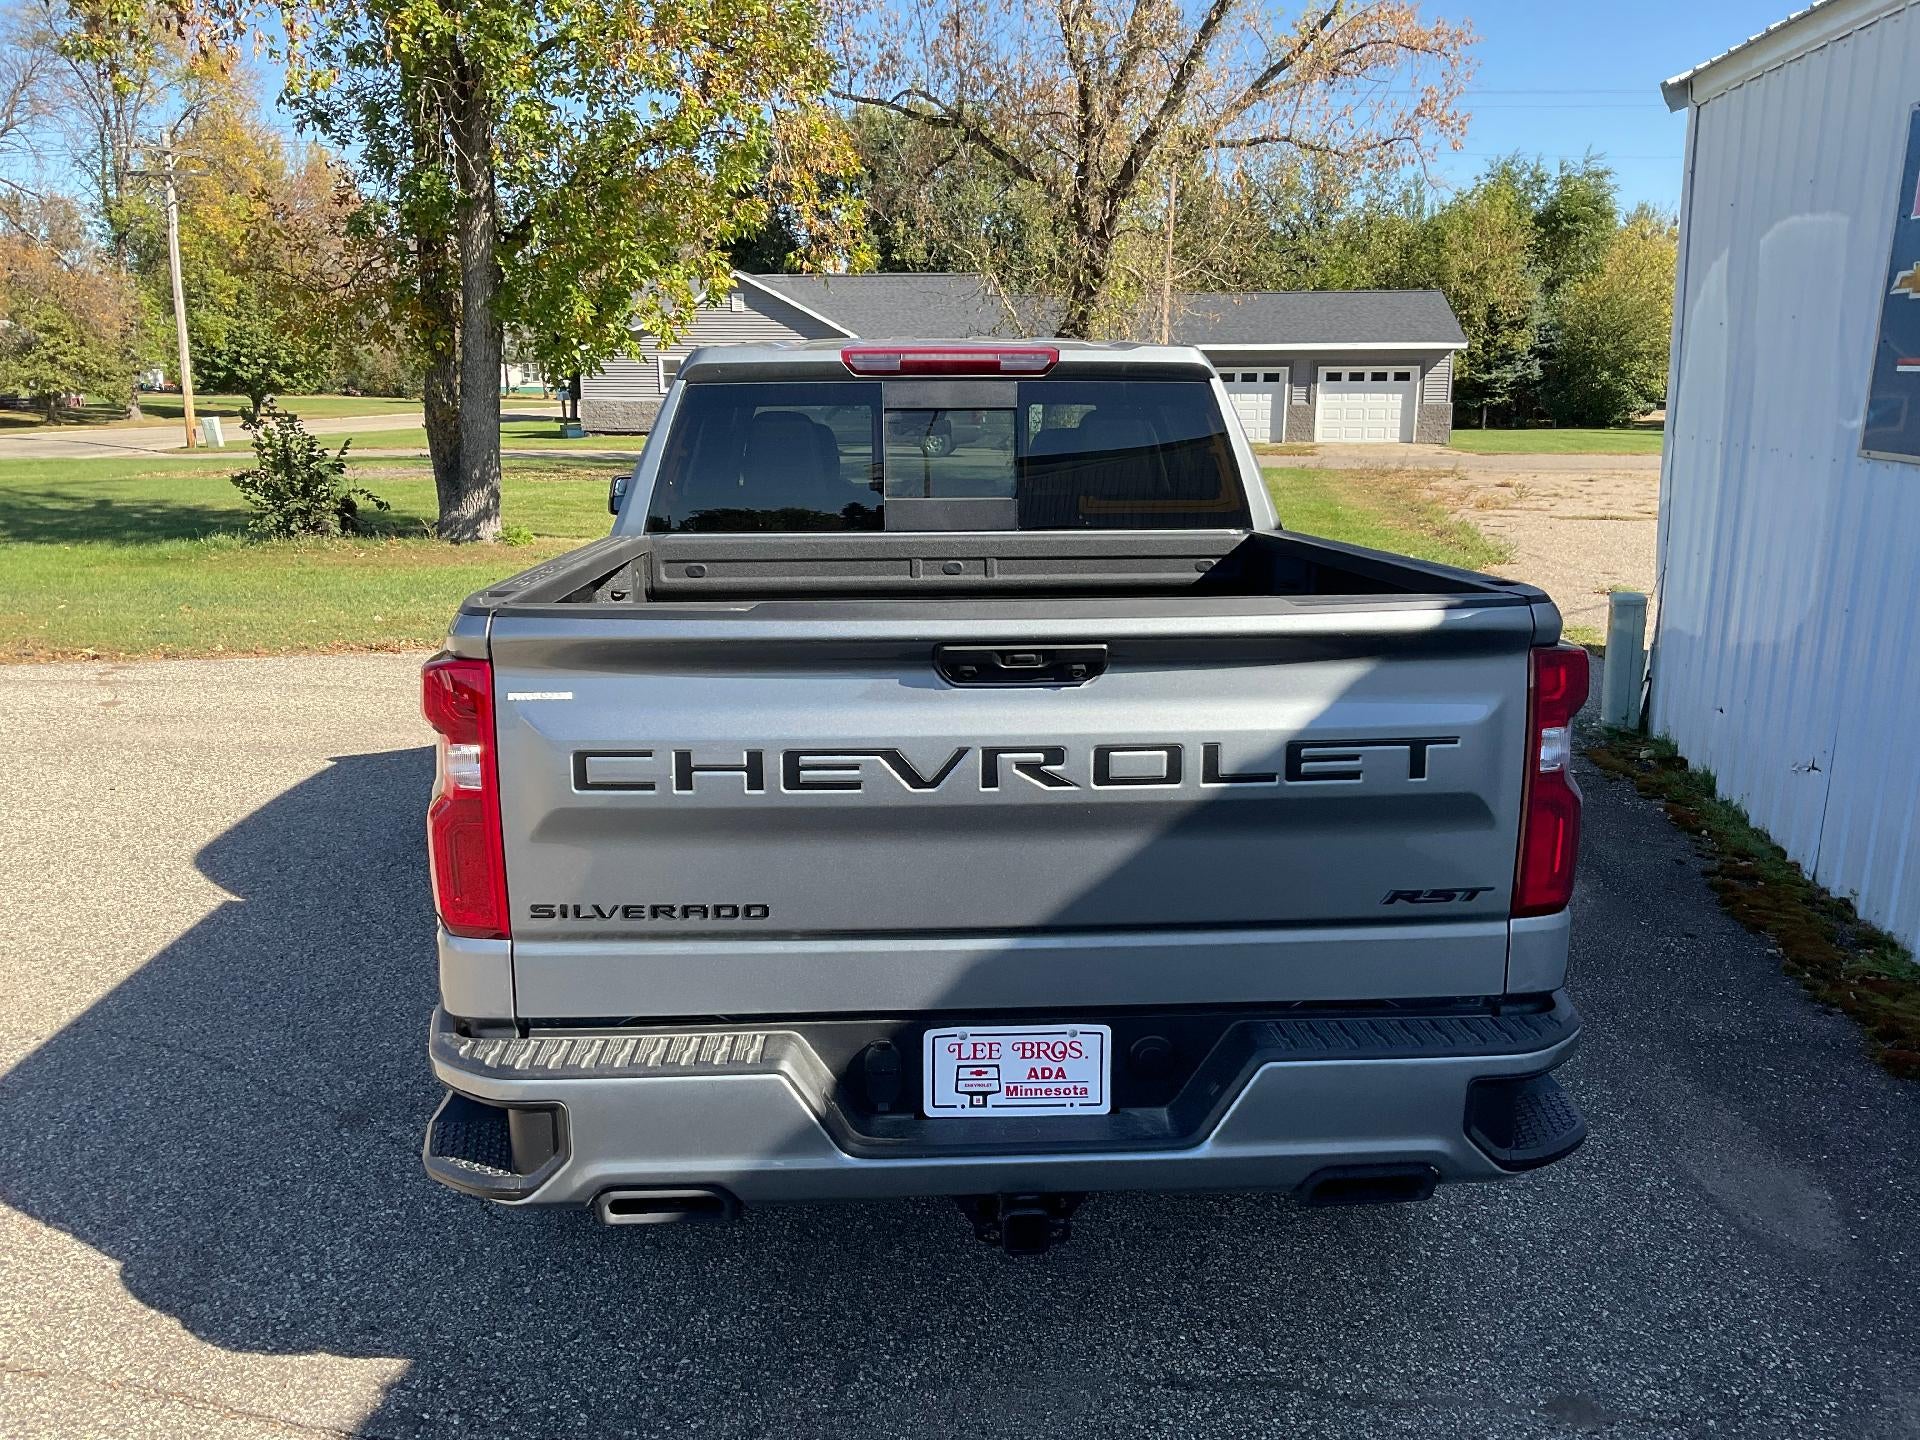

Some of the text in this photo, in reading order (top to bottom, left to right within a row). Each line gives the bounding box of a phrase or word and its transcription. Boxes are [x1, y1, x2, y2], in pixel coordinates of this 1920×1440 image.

[571, 736, 1461, 795] CHEVROLET
[1379, 887, 1495, 905] RST
[529, 903, 770, 920] SILVERADO
[947, 1040, 1089, 1063] LEE BROS.
[1026, 1066, 1067, 1080] ADA
[1005, 1084, 1089, 1097] Minnesota
